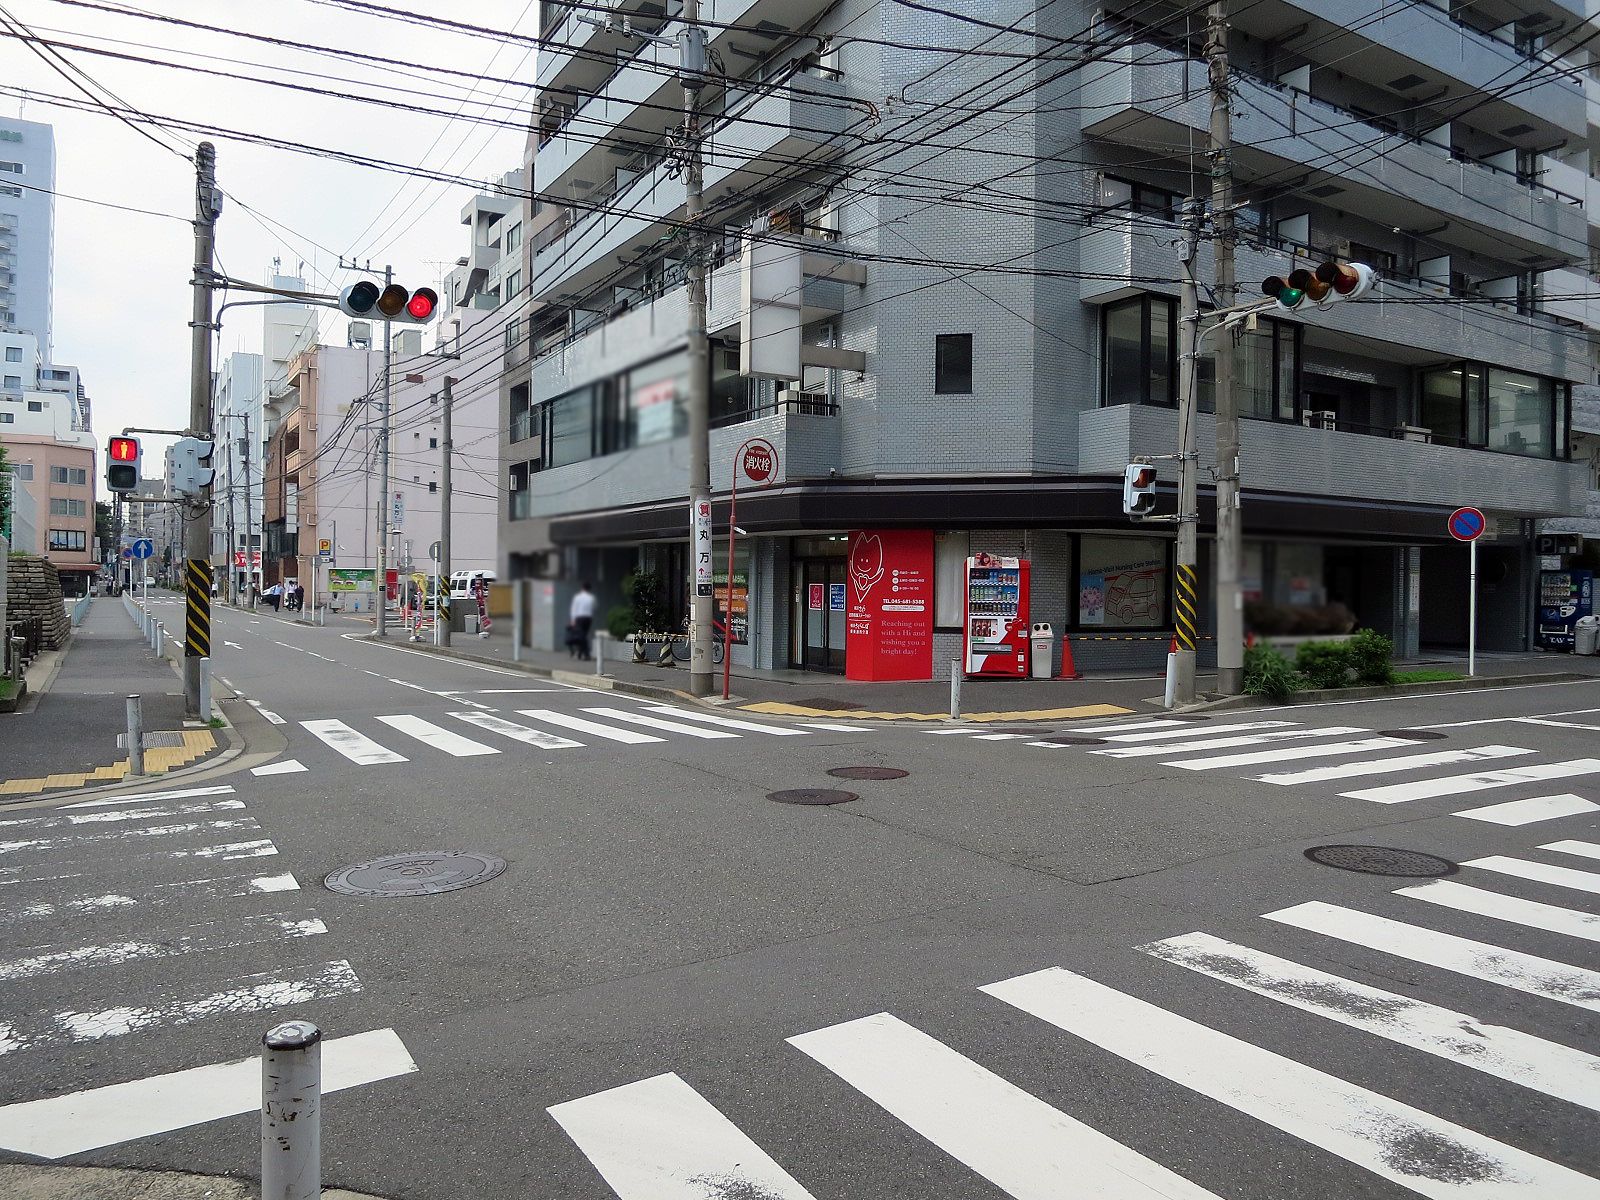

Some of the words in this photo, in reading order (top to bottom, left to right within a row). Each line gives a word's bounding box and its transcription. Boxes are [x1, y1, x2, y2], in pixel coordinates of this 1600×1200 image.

[745, 455, 770, 472] 消火栓
[321, 541, 329, 549] P
[1541, 538, 1552, 551] P
[881, 620, 912, 628] Reaching
[881, 639, 906, 647] wishing
[881, 648, 901, 656] bright
[902, 648, 917, 657] day!
